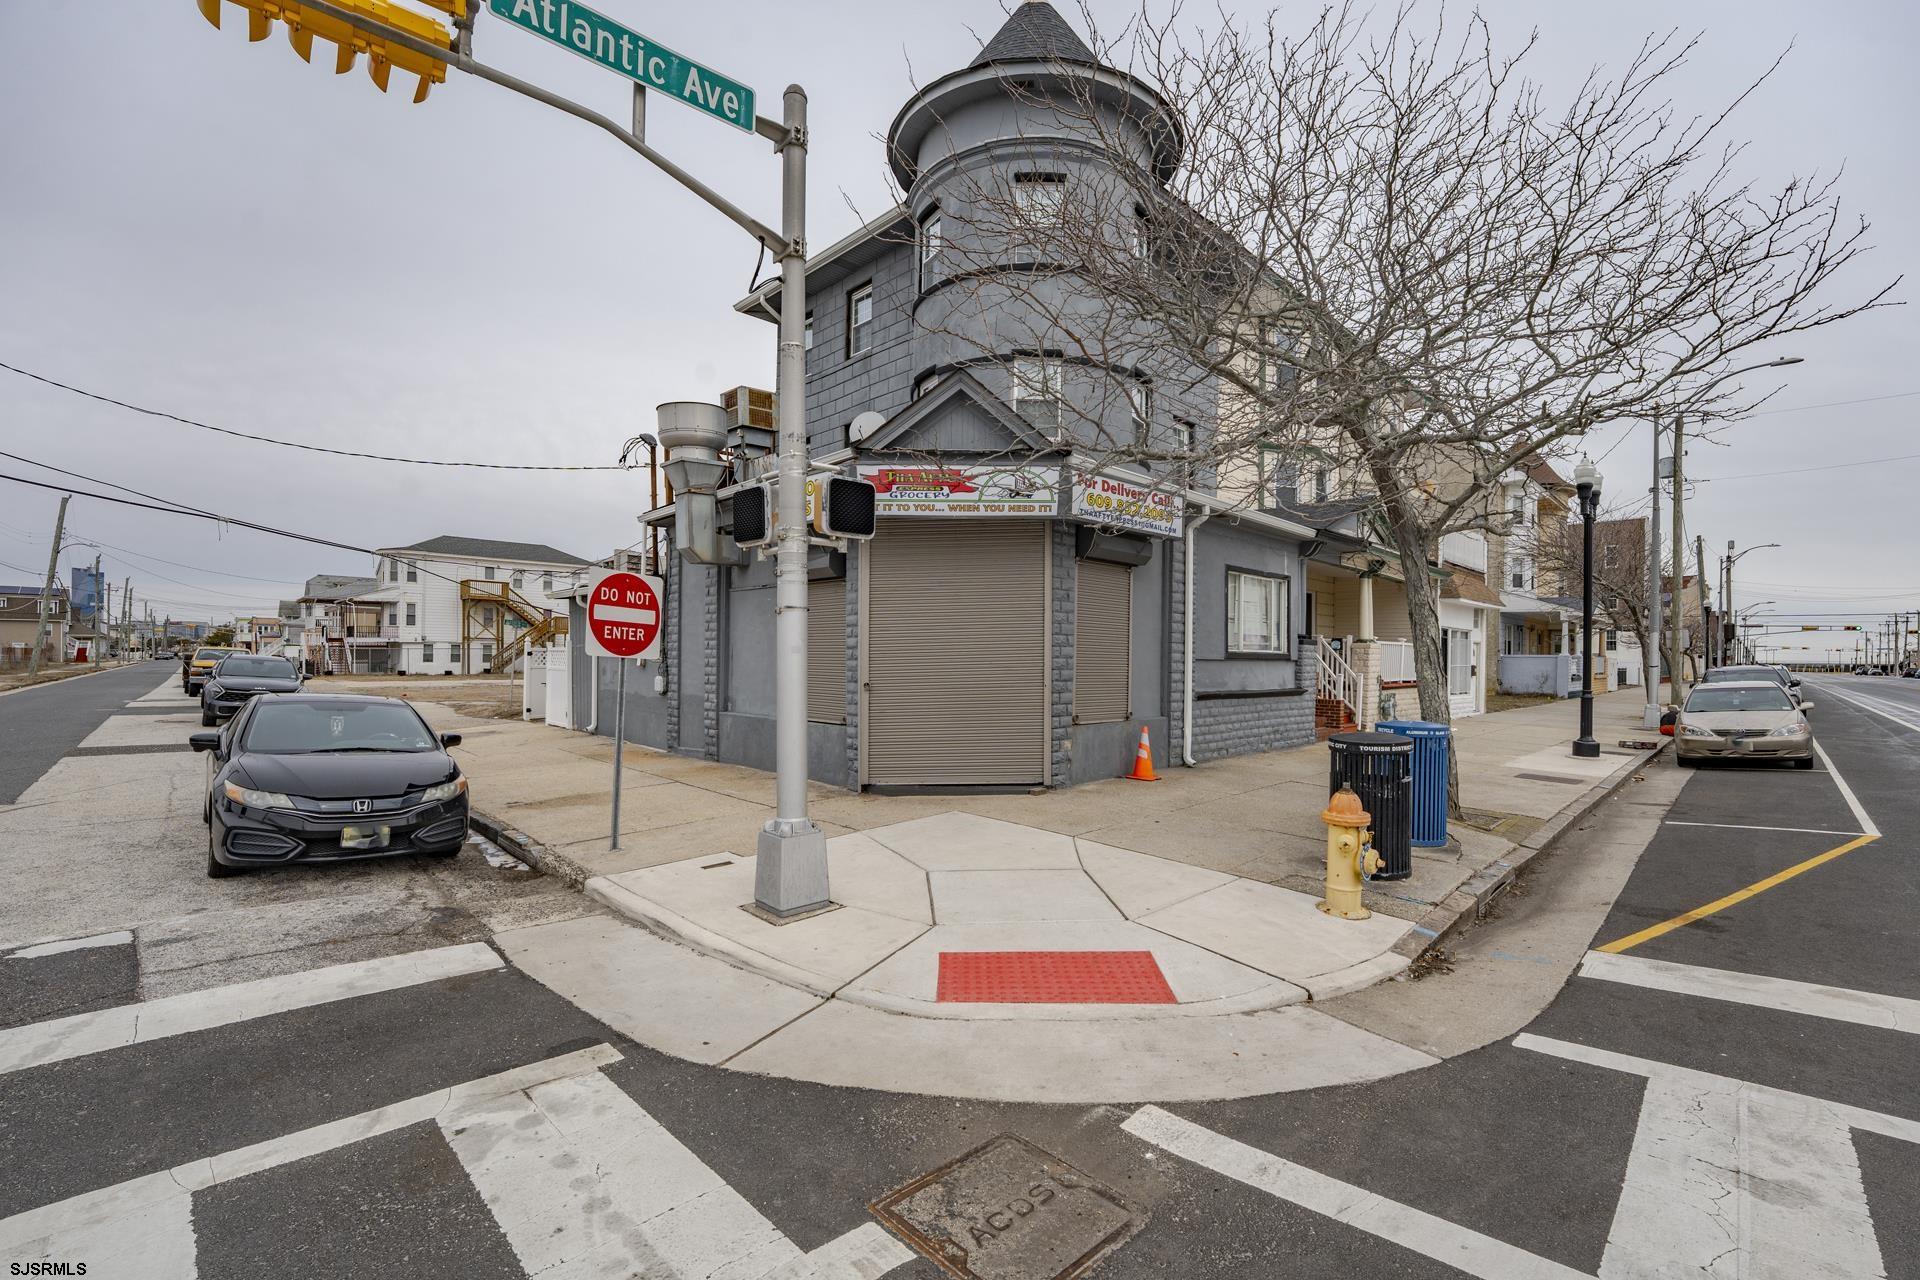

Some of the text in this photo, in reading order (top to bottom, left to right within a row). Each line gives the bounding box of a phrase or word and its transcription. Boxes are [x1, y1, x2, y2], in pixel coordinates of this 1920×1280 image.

[511, 0, 739, 119] Atlantic Ave
[890, 491, 950, 499] GROCERY
[896, 504, 911, 512] TO
[947, 504, 981, 513] WHEN
[983, 504, 1006, 513] YOU
[1008, 504, 1036, 513] NEED
[600, 586, 651, 606] DO NOT
[604, 625, 645, 641] ENTER
[968, 1183, 1055, 1249] ACDS
